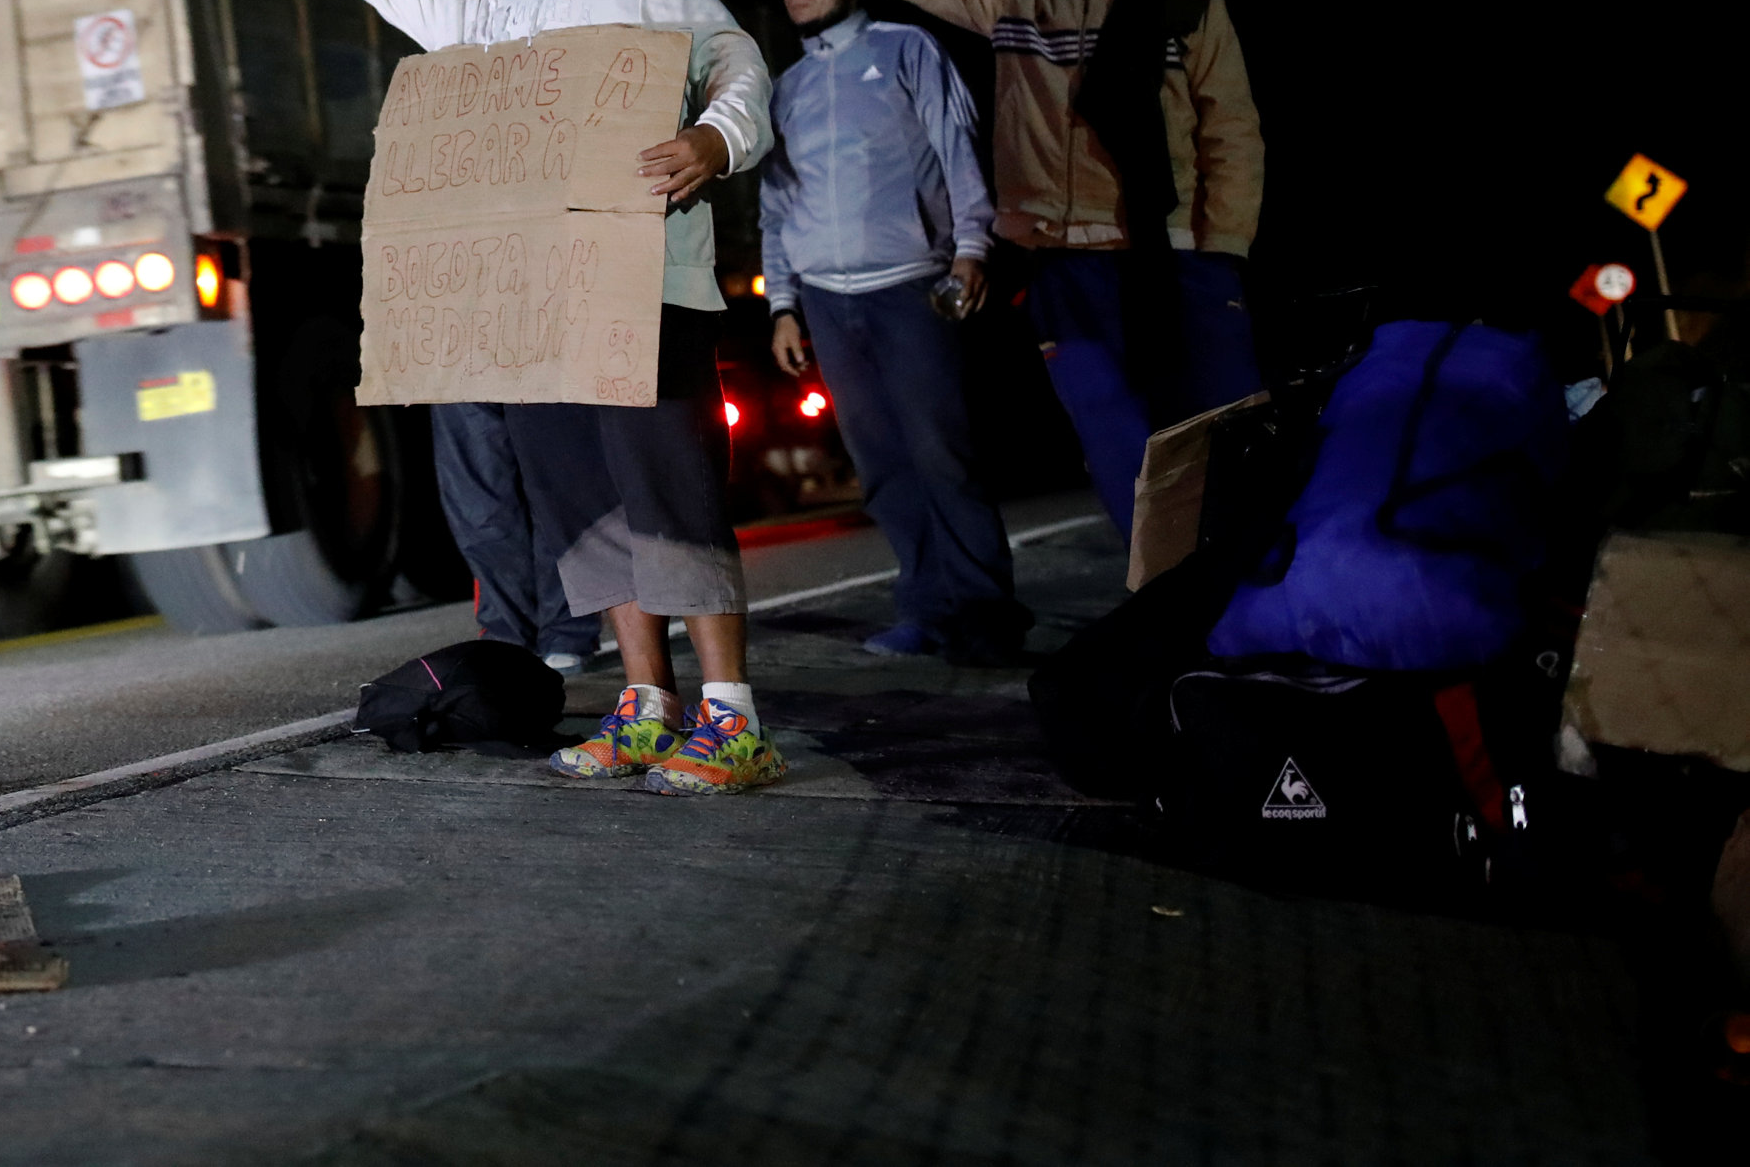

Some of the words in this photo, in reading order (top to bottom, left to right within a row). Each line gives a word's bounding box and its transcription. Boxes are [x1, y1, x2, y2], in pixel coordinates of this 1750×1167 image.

[385, 48, 567, 128] AYUDAME
[594, 47, 647, 110] A
[382, 121, 531, 197] LLEGAR
[379, 233, 527, 303] BOGOTA
